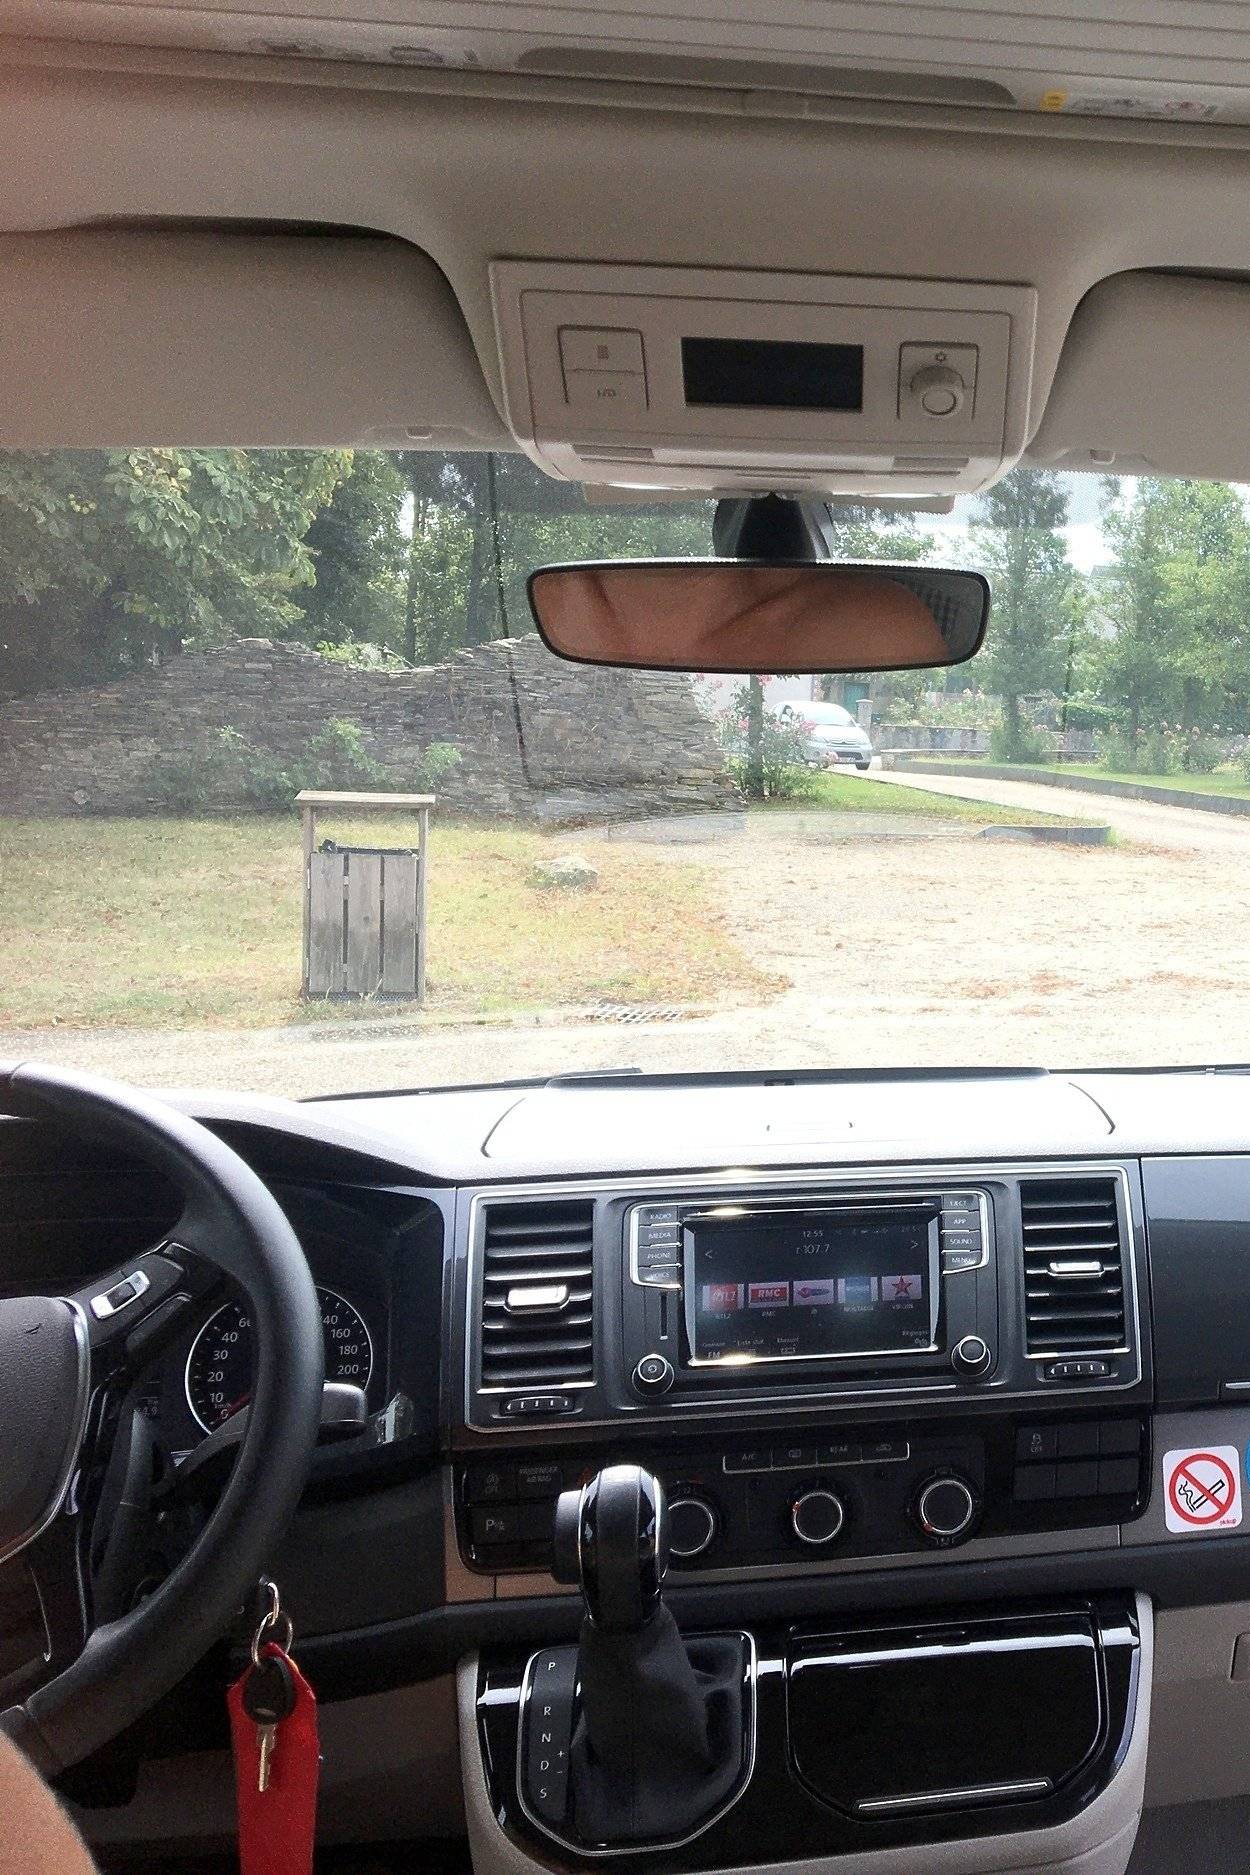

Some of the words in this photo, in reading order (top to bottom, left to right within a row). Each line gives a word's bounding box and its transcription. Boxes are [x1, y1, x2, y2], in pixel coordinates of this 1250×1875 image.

[648, 1232, 672, 1240] MEDIA
[647, 1252, 671, 1260] PHONE
[758, 1288, 781, 1298] RMC
[323, 1314, 338, 1325] 40
[221, 1331, 238, 1343] 40
[331, 1328, 351, 1339] 160
[213, 1350, 229, 1360] 30
[339, 1345, 358, 1356] 180
[337, 1364, 359, 1375] 200
[207, 1371, 224, 1382] 20
[210, 1393, 224, 1403] 10
[547, 1661, 556, 1671] P
[543, 1706, 551, 1716] R
[541, 1733, 551, 1743] N
[540, 1760, 549, 1771] D
[540, 1788, 547, 1799] S
